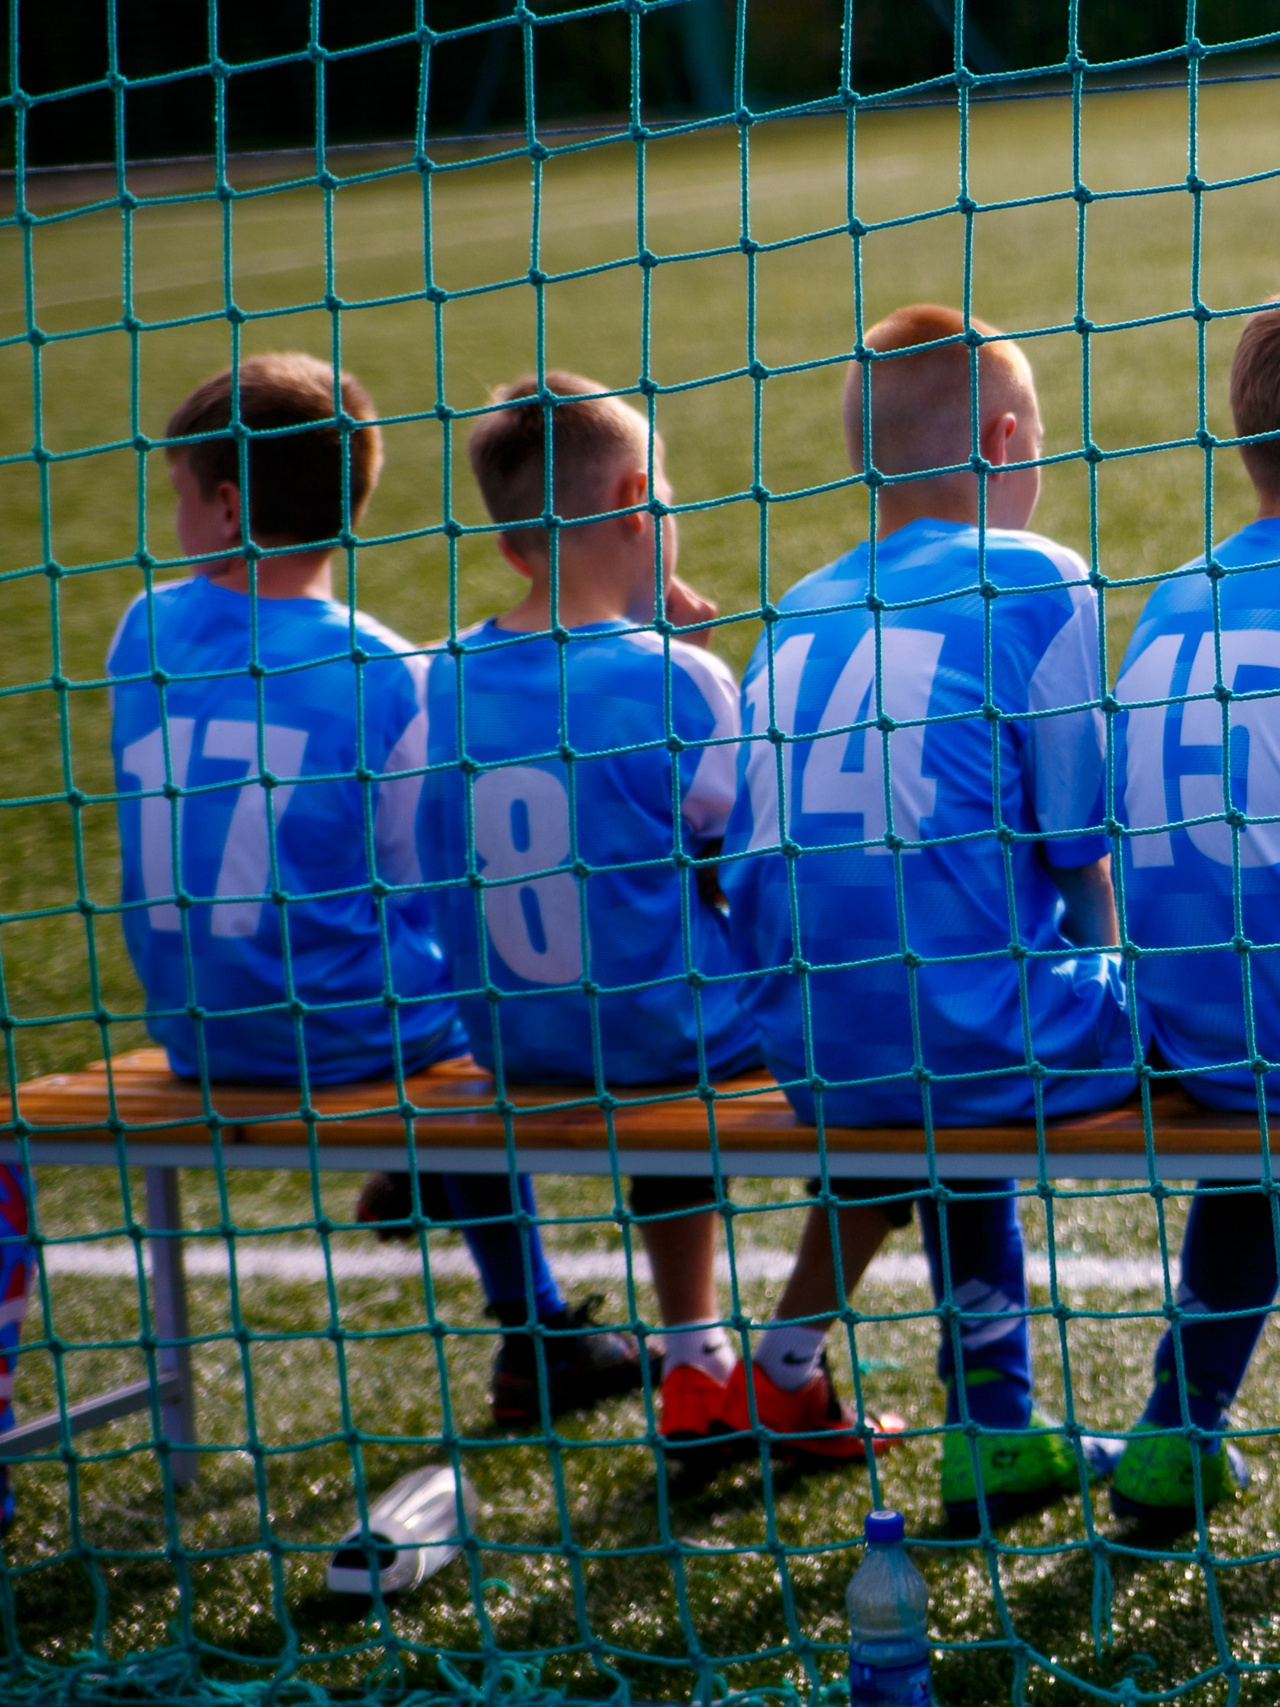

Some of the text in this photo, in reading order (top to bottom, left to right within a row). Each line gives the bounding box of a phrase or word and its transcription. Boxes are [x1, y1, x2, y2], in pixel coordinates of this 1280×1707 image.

[121, 717, 309, 938] 17
[745, 627, 945, 855] 14
[472, 765, 592, 985] 8
